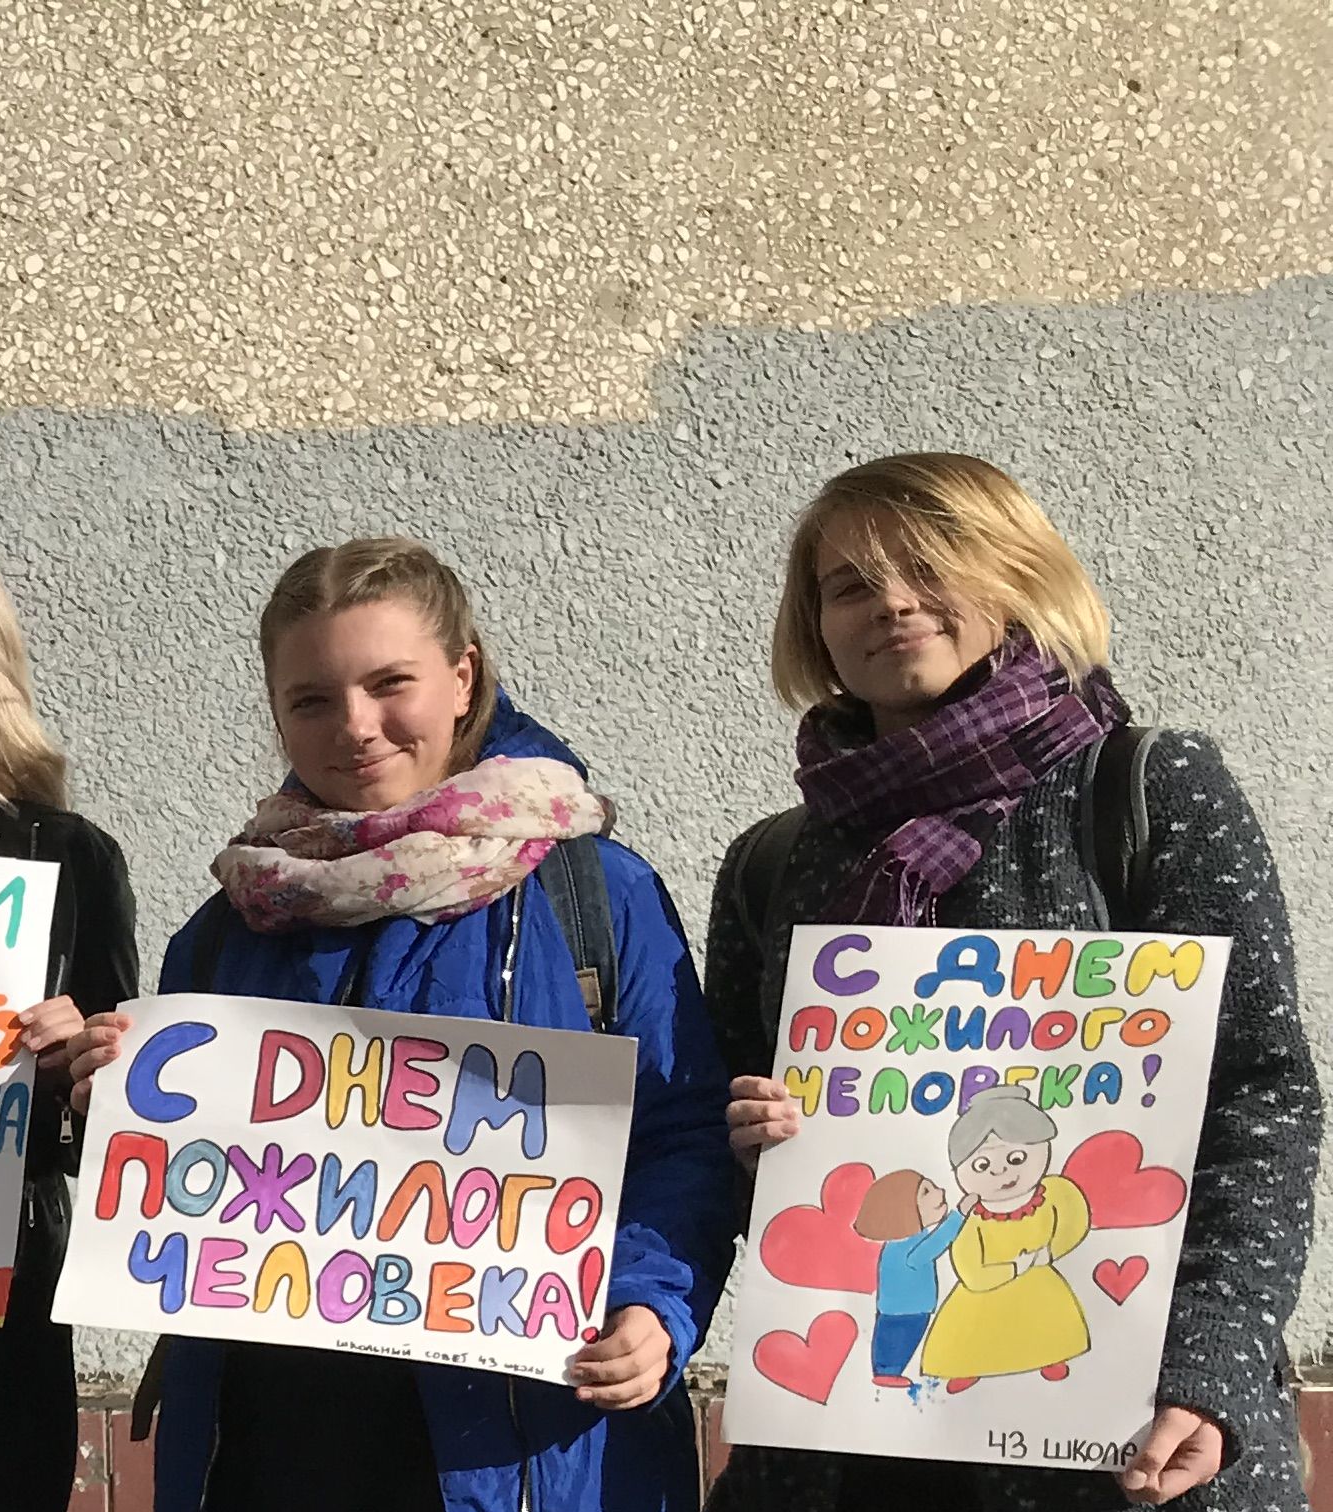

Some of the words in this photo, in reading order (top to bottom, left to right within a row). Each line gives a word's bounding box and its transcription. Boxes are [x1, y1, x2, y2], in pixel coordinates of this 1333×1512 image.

[813, 933, 880, 997] С
[914, 934, 1205, 1000] ДНЕМ
[789, 1003, 1171, 1055] ПОЖИЛОГО
[126, 1021, 218, 1123] С
[95, 1131, 603, 1254] ПОЖИЛОГО
[128, 1230, 605, 1344] ЧЕЛОВЕКА!
[988, 1429, 1028, 1459] 43
